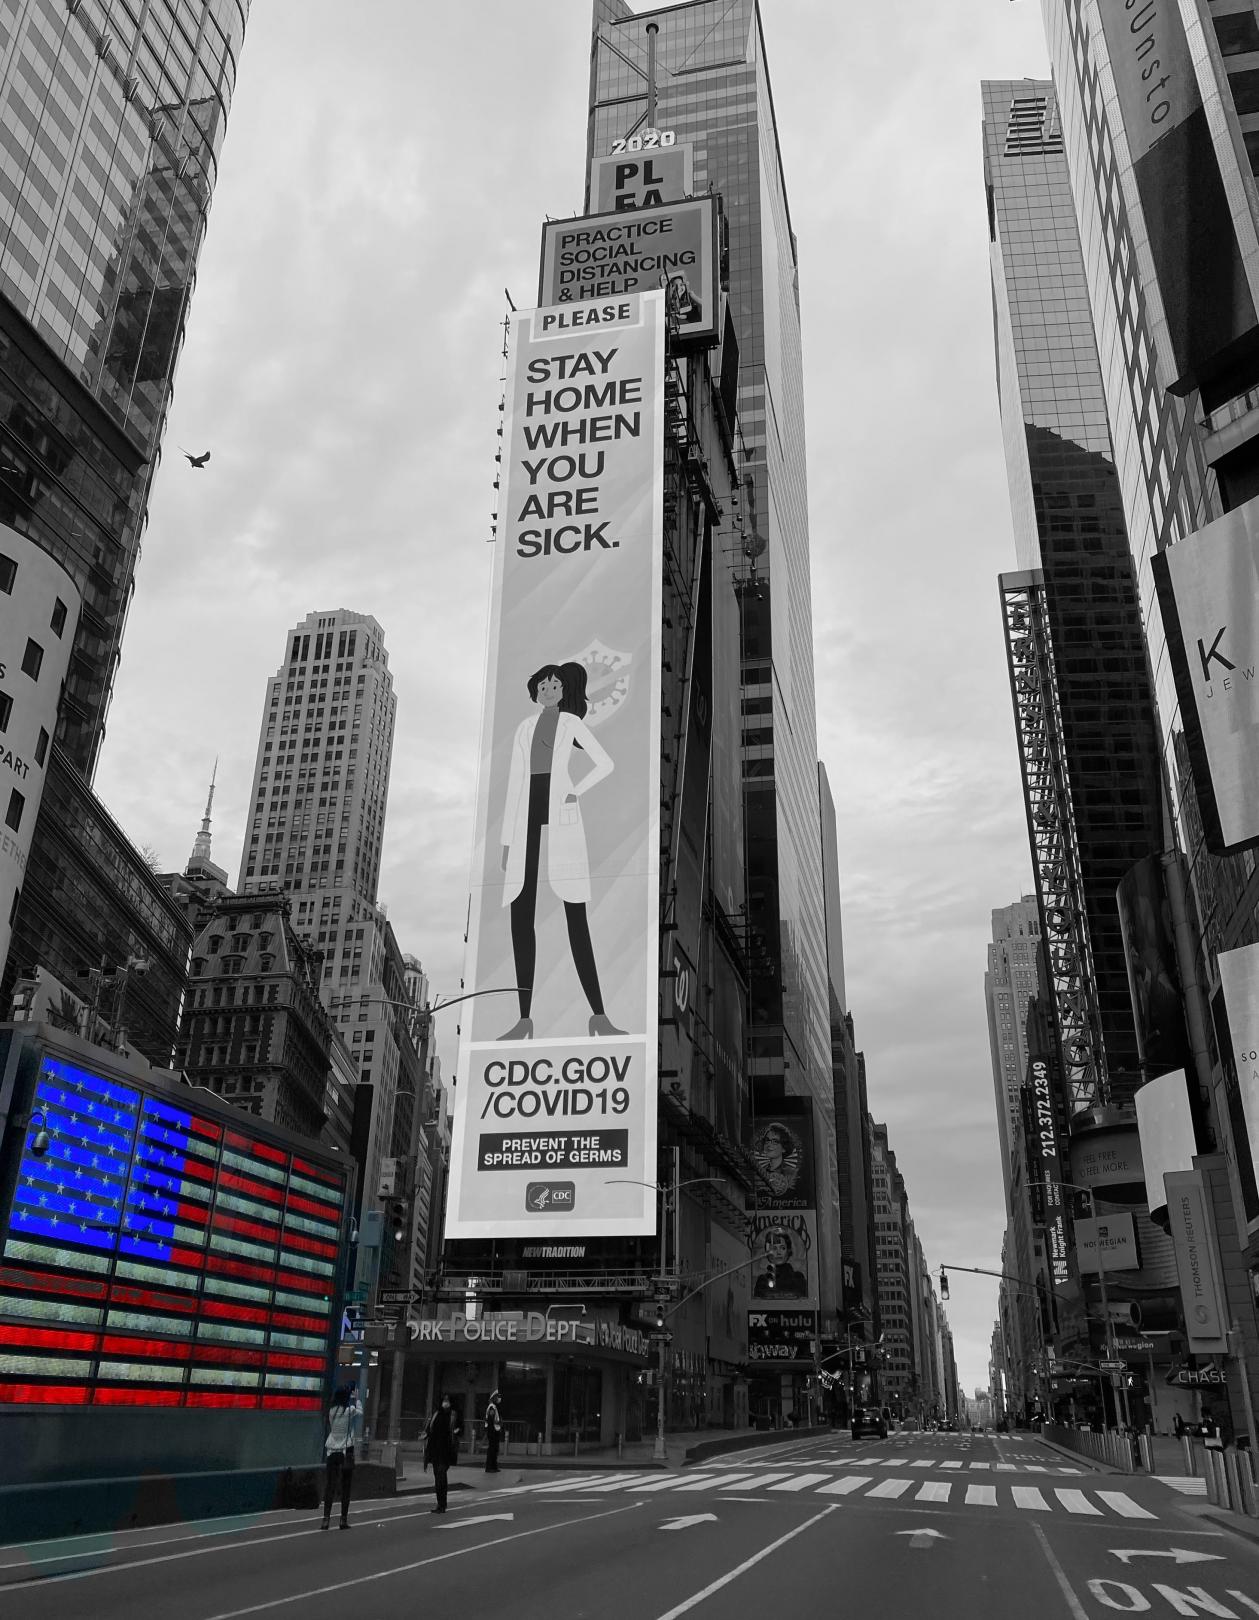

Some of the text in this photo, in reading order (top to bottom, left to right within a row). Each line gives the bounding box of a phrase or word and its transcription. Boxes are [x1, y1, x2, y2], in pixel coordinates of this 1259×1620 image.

[612, 130, 676, 156] 2020
[615, 160, 664, 190] PL
[561, 218, 673, 249] PRACTICE
[559, 242, 642, 267] SOCIAL
[559, 250, 696, 285] DISTANCING
[558, 277, 639, 302] & HELP
[542, 303, 631, 331] PLEASE
[526, 348, 619, 384] STAY
[526, 377, 642, 417] HOME
[523, 411, 641, 451] WHEN
[520, 450, 605, 485] YOU
[517, 486, 599, 522] ARE
[516, 521, 620, 558] SICK.
[483, 1055, 632, 1088] CDC.GOV
[480, 1087, 630, 1119] /COVID19
[1033, 1062, 1056, 1157] 212.372.2349
[484, 1149, 622, 1166] SPREAD OF GERMS
[502, 1136, 600, 1151] PREVENT THE
[1103, 1161, 1128, 1173] MORE
[553, 1191, 571, 1200] CDC
[1049, 1226, 1059, 1258] Newmark
[1055, 1216, 1067, 1258] Knight Frank
[1181, 1197, 1204, 1297] THOMSON REUTERS
[452, 1312, 517, 1341] POLICE
[526, 1312, 580, 1341] DEPT
[749, 1314, 767, 1327] FX
[780, 1314, 811, 1327] hulu
[1178, 1370, 1228, 1383] CHASE
